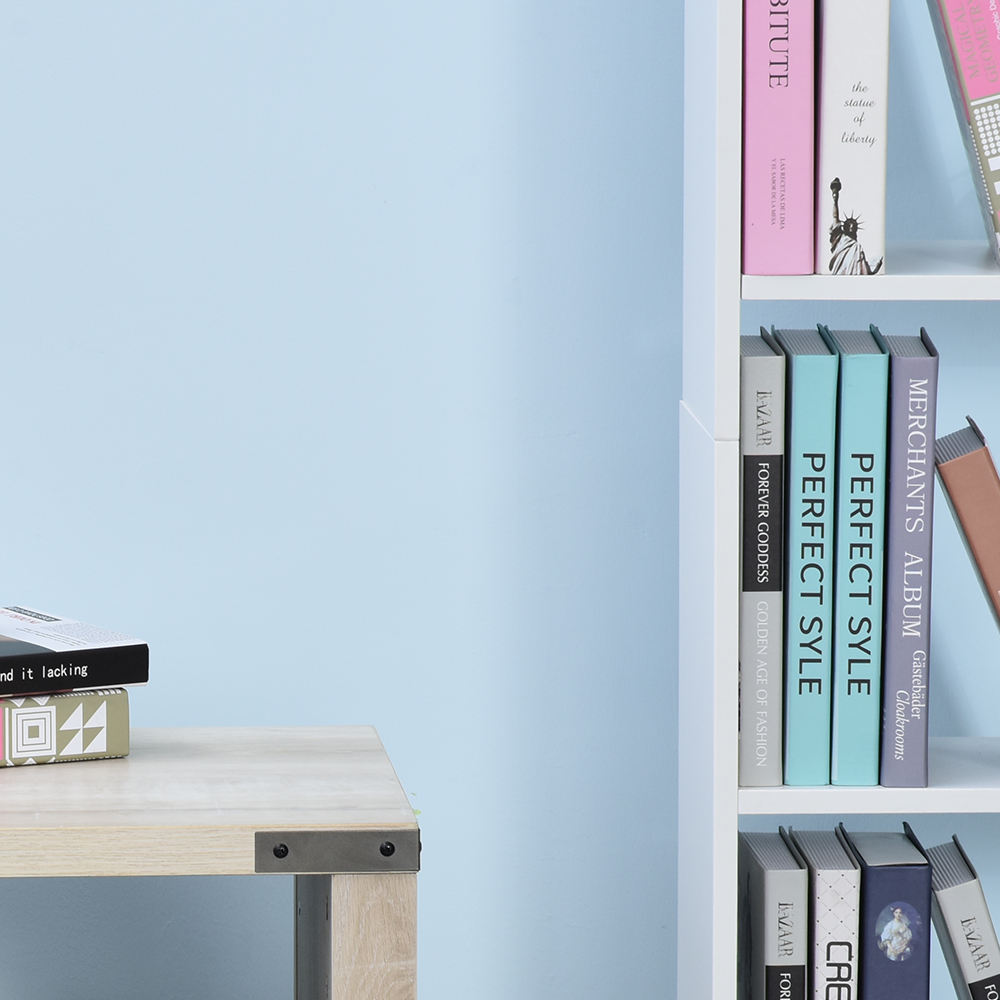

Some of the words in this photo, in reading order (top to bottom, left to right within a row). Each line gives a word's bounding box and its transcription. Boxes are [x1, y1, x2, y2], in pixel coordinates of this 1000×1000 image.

[952, 2, 981, 79] MAGICAL
[968, 0, 999, 83] GEOMETR
[843, 99, 876, 108] statue
[851, 81, 869, 92] the
[841, 131, 877, 148] liberty
[853, 111, 866, 127] of
[905, 378, 929, 533] MERCHANTS
[757, 462, 770, 518] FOREVER
[757, 521, 770, 583] GODDESS
[800, 453, 826, 606] PERFECT
[848, 453, 875, 606] PERFECT
[902, 551, 924, 638] ALBUM
[756, 601, 769, 655] GOLDEN
[798, 615, 824, 696] SYLE
[847, 616, 873, 696] SYLE
[21, 667, 34, 680] it
[42, 662, 88, 679] lacking
[756, 659, 768, 685] AGE
[756, 689, 768, 706] OF
[911, 650, 927, 720] Gästebäder
[755, 711, 768, 767] FASHION
[894, 689, 910, 761] Cloakrooms
